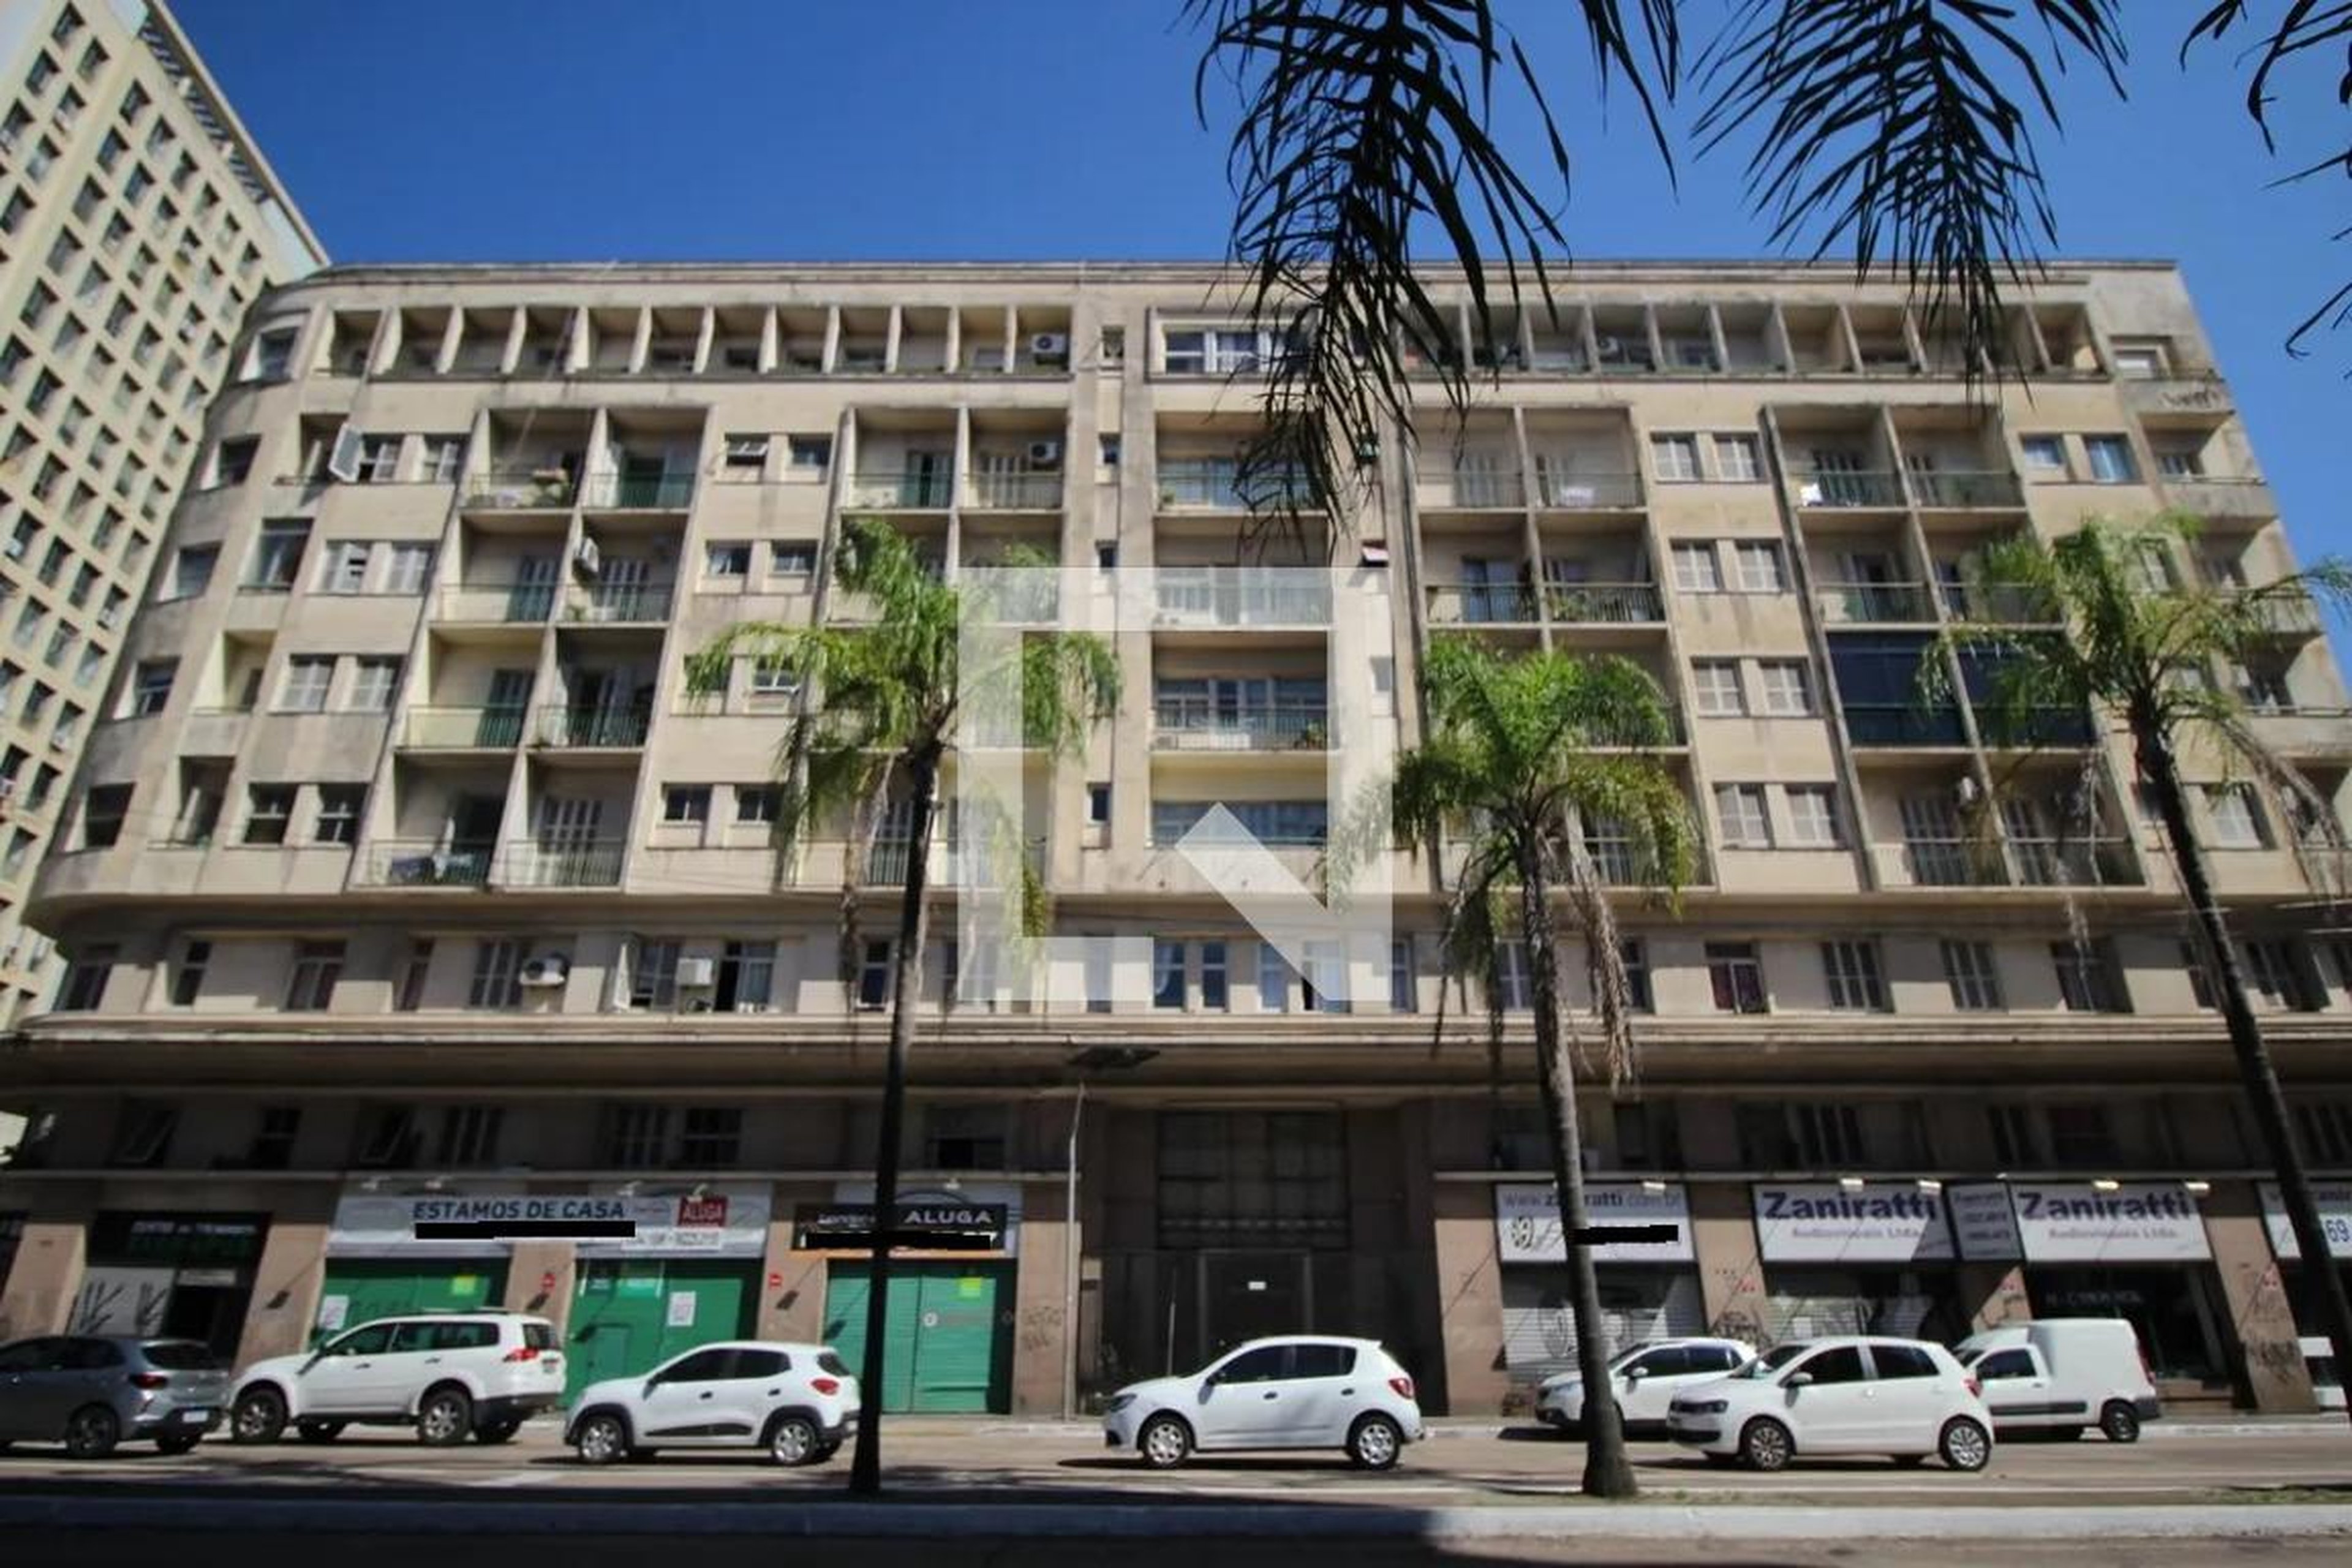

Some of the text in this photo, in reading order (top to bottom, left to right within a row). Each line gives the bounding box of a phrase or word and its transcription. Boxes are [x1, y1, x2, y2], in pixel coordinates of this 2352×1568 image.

[413, 1201, 521, 1219] ESTAMOS
[526, 1200, 558, 1218] DE
[562, 1200, 624, 1218] CASA
[1762, 1191, 1936, 1219] Zaniratti
[2018, 1191, 2192, 1219] Zaniratti
[904, 1210, 993, 1224] ALUGA
